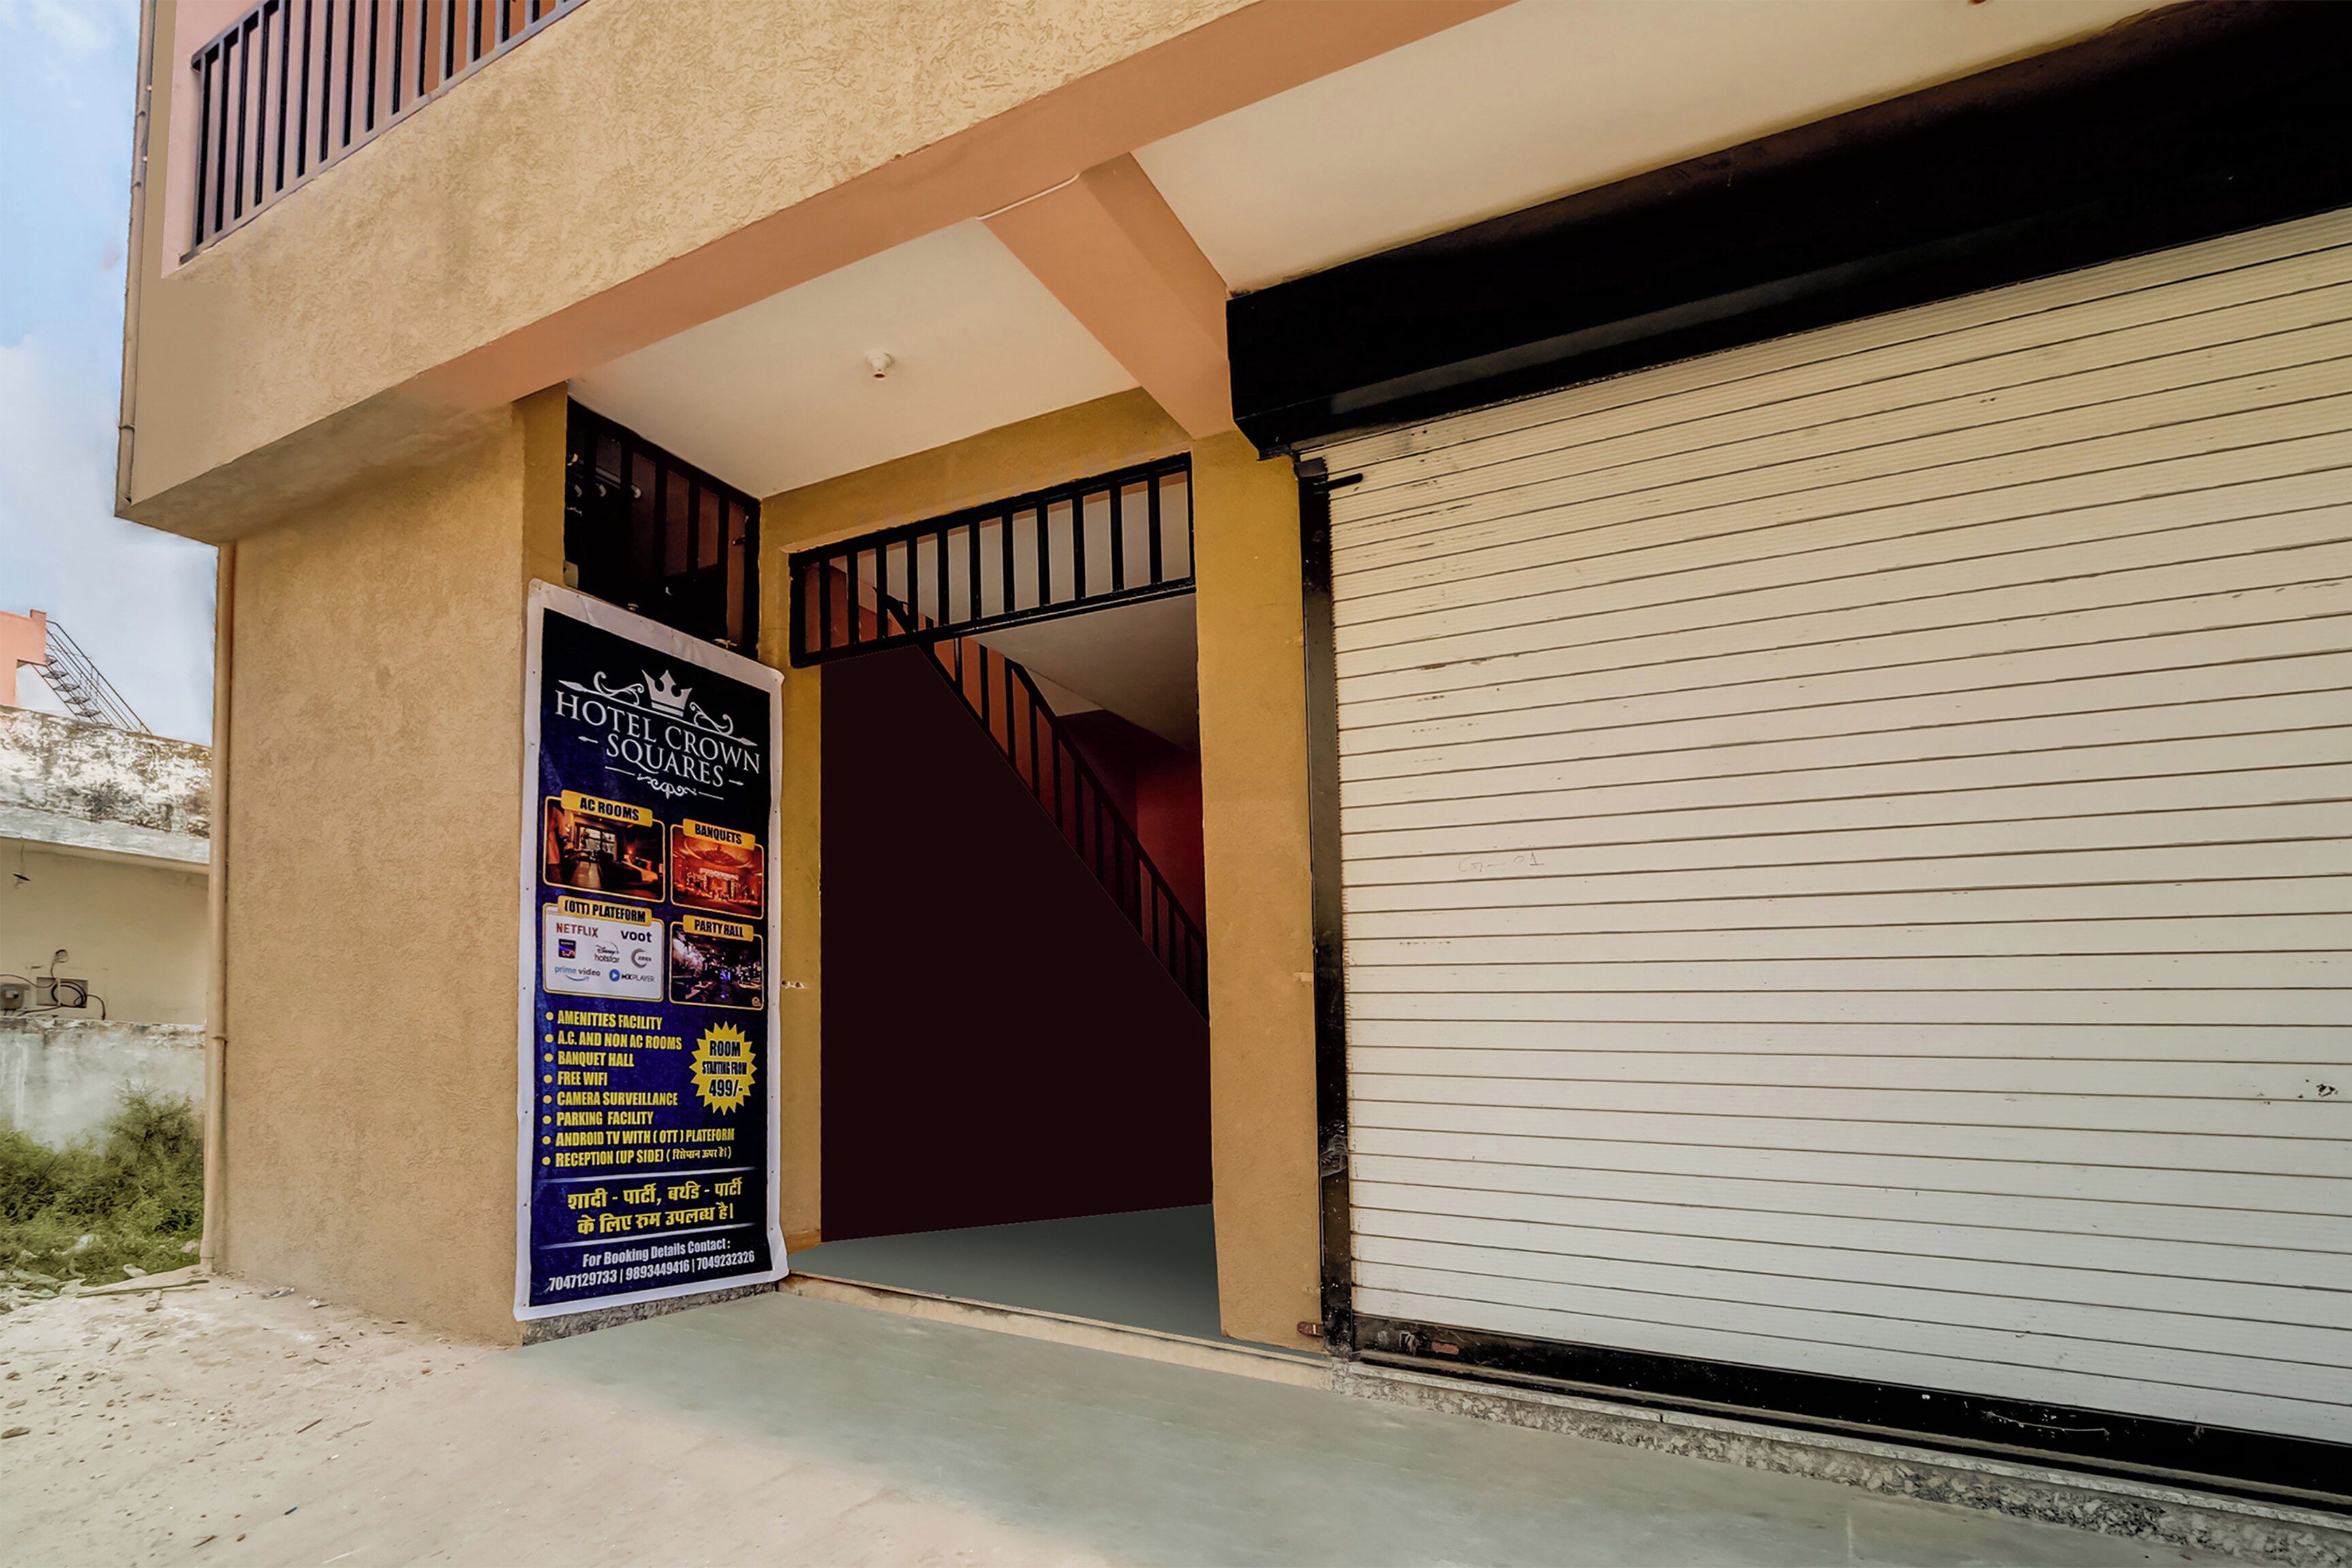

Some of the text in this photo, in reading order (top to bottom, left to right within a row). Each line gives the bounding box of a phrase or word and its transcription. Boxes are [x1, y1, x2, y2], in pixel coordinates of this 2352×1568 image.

[555, 691, 760, 774] HOTEL CROWN
[606, 734, 724, 787] SQUARES
[580, 798, 639, 821] AC ROOMS
[695, 823, 742, 844] BANQUETS
[565, 900, 645, 922] (OTT) PLATEFORM
[556, 923, 599, 938] NETFLIX
[621, 930, 652, 943] voot
[694, 919, 744, 938] PARTY HALL
[594, 953, 620, 964] hotstar
[555, 966, 600, 977] prime video
[557, 1010, 663, 1030] AMENITIES FACILITY
[557, 1032, 682, 1049] A.C. AND NON AC ROOMS
[710, 1041, 740, 1056] ROOM
[557, 1051, 634, 1067] BANQUET HALL
[557, 1071, 608, 1085] FREE WIFI
[709, 1079, 742, 1096] 499/-
[557, 1091, 678, 1106] CAMERA SURVEILLANCE
[557, 1111, 653, 1126] PARKING FACILITY
[555, 1131, 604, 1146] ANDROID
[606, 1130, 620, 1144] TV
[622, 1130, 650, 1144] WITH
[685, 1128, 735, 1142] PLATEFORM
[555, 1149, 613, 1167] RECEPTION
[568, 1188, 608, 1209] शादी
[715, 1177, 742, 1196] पार्टी
[577, 1215, 595, 1235] के
[600, 1213, 632, 1233] लिए
[666, 1207, 715, 1226] उपलब्ध
[583, 1254, 601, 1267] For
[604, 1248, 649, 1265] Booking
[651, 1243, 685, 1259] Details
[549, 1270, 617, 1292] 7047129733
[625, 1260, 689, 1281] 9893449416
[697, 1251, 755, 1270] 7049232326
